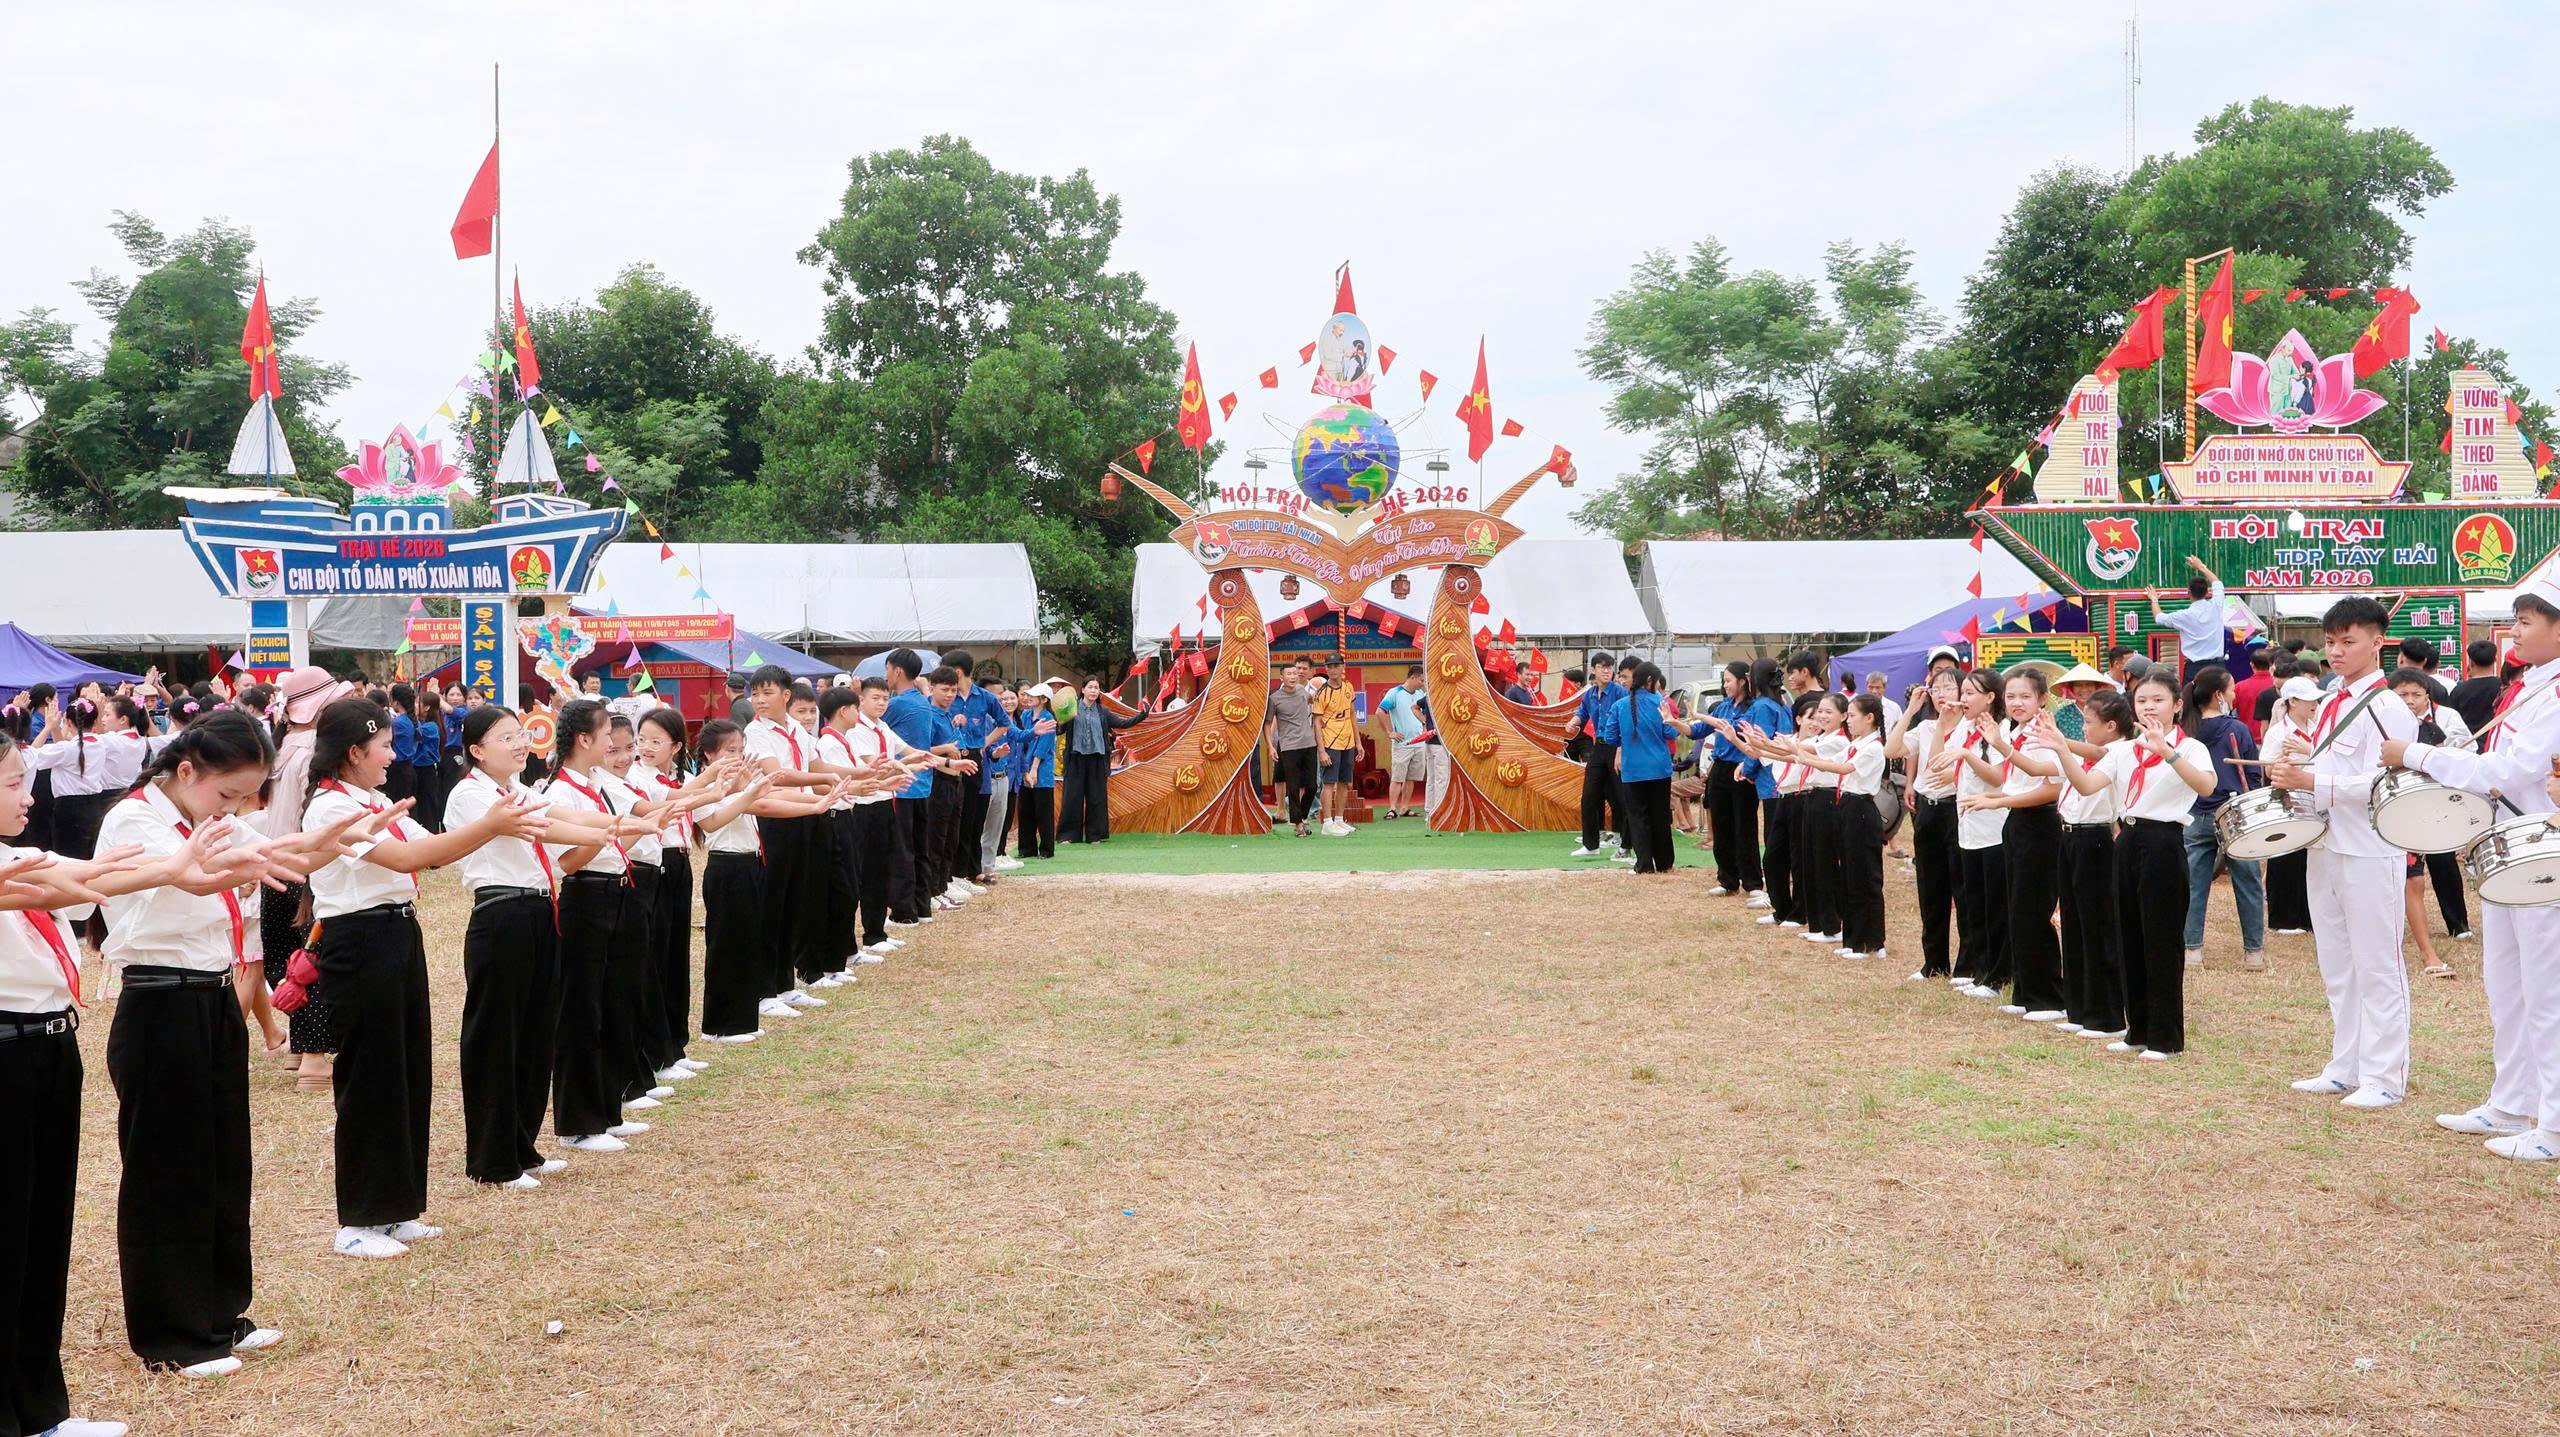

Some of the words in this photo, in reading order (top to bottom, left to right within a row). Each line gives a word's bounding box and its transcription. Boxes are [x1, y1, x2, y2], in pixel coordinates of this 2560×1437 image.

[2082, 386, 2108, 412] TUỔI
[2464, 386, 2498, 408] VỮNG
[2086, 416, 2108, 440] TRẺ
[2464, 418, 2494, 436] TIN
[2082, 443, 2109, 466] TÂY
[2208, 445, 2230, 462] ĐỜI
[2234, 445, 2255, 462] ĐỜI
[2258, 445, 2286, 462] NHỚ
[2288, 448, 2305, 462] ƠN
[2309, 444, 2334, 462] CHỦ
[2337, 448, 2365, 466] TỊCH
[2463, 446, 2494, 462] THEO
[2084, 470, 2108, 496] HẢI
[2196, 465, 2221, 484] HỒ
[2227, 464, 2257, 484] CHÍ
[2264, 470, 2314, 484] MINH
[2319, 468, 2337, 484] VĨ
[2342, 470, 2374, 486] ĐẠI
[2462, 468, 2498, 492] ĐẢNG
[1220, 482, 1258, 506] HỘI
[1382, 488, 1409, 513] HÈ
[1414, 486, 1469, 504] 2026
[1232, 520, 1246, 531] CHI
[1264, 520, 1280, 531] TDP
[1282, 520, 1298, 536] HẢI
[2212, 514, 2278, 544] HỘI
[2302, 519, 2384, 544] TRẠI
[339, 540, 377, 560] TRẠI
[404, 538, 446, 558] 2026
[2275, 548, 2324, 565] TDP
[2332, 546, 2385, 565] TÂY
[2394, 542, 2437, 564] HẢI
[288, 567, 314, 591] CHI
[316, 563, 341, 594] ĐỘI
[342, 560, 362, 590] TỔ
[364, 563, 395, 590] DÂN
[398, 560, 428, 590] PHỐ
[430, 563, 469, 589] XUÂN
[2246, 567, 2303, 587] NĂM
[2311, 570, 2372, 587] 2026
[2438, 604, 2454, 624] TRẺ
[432, 622, 447, 632] LIỆT
[1344, 624, 1369, 634] 2026
[1440, 616, 1462, 638] Kiến
[251, 637, 288, 647] CHXHCN
[2440, 635, 2456, 656] HẢI
[250, 650, 268, 664] VIỆT
[268, 652, 289, 662] NAM
[1229, 656, 1254, 680] Hào
[1441, 652, 1464, 678] Tạo
[1222, 694, 1250, 722] Trang
[1202, 730, 1228, 755] Sử
[1470, 733, 1500, 754] Nguyên
[1176, 764, 1200, 790] Vàng
[1497, 761, 1524, 782] Mới
